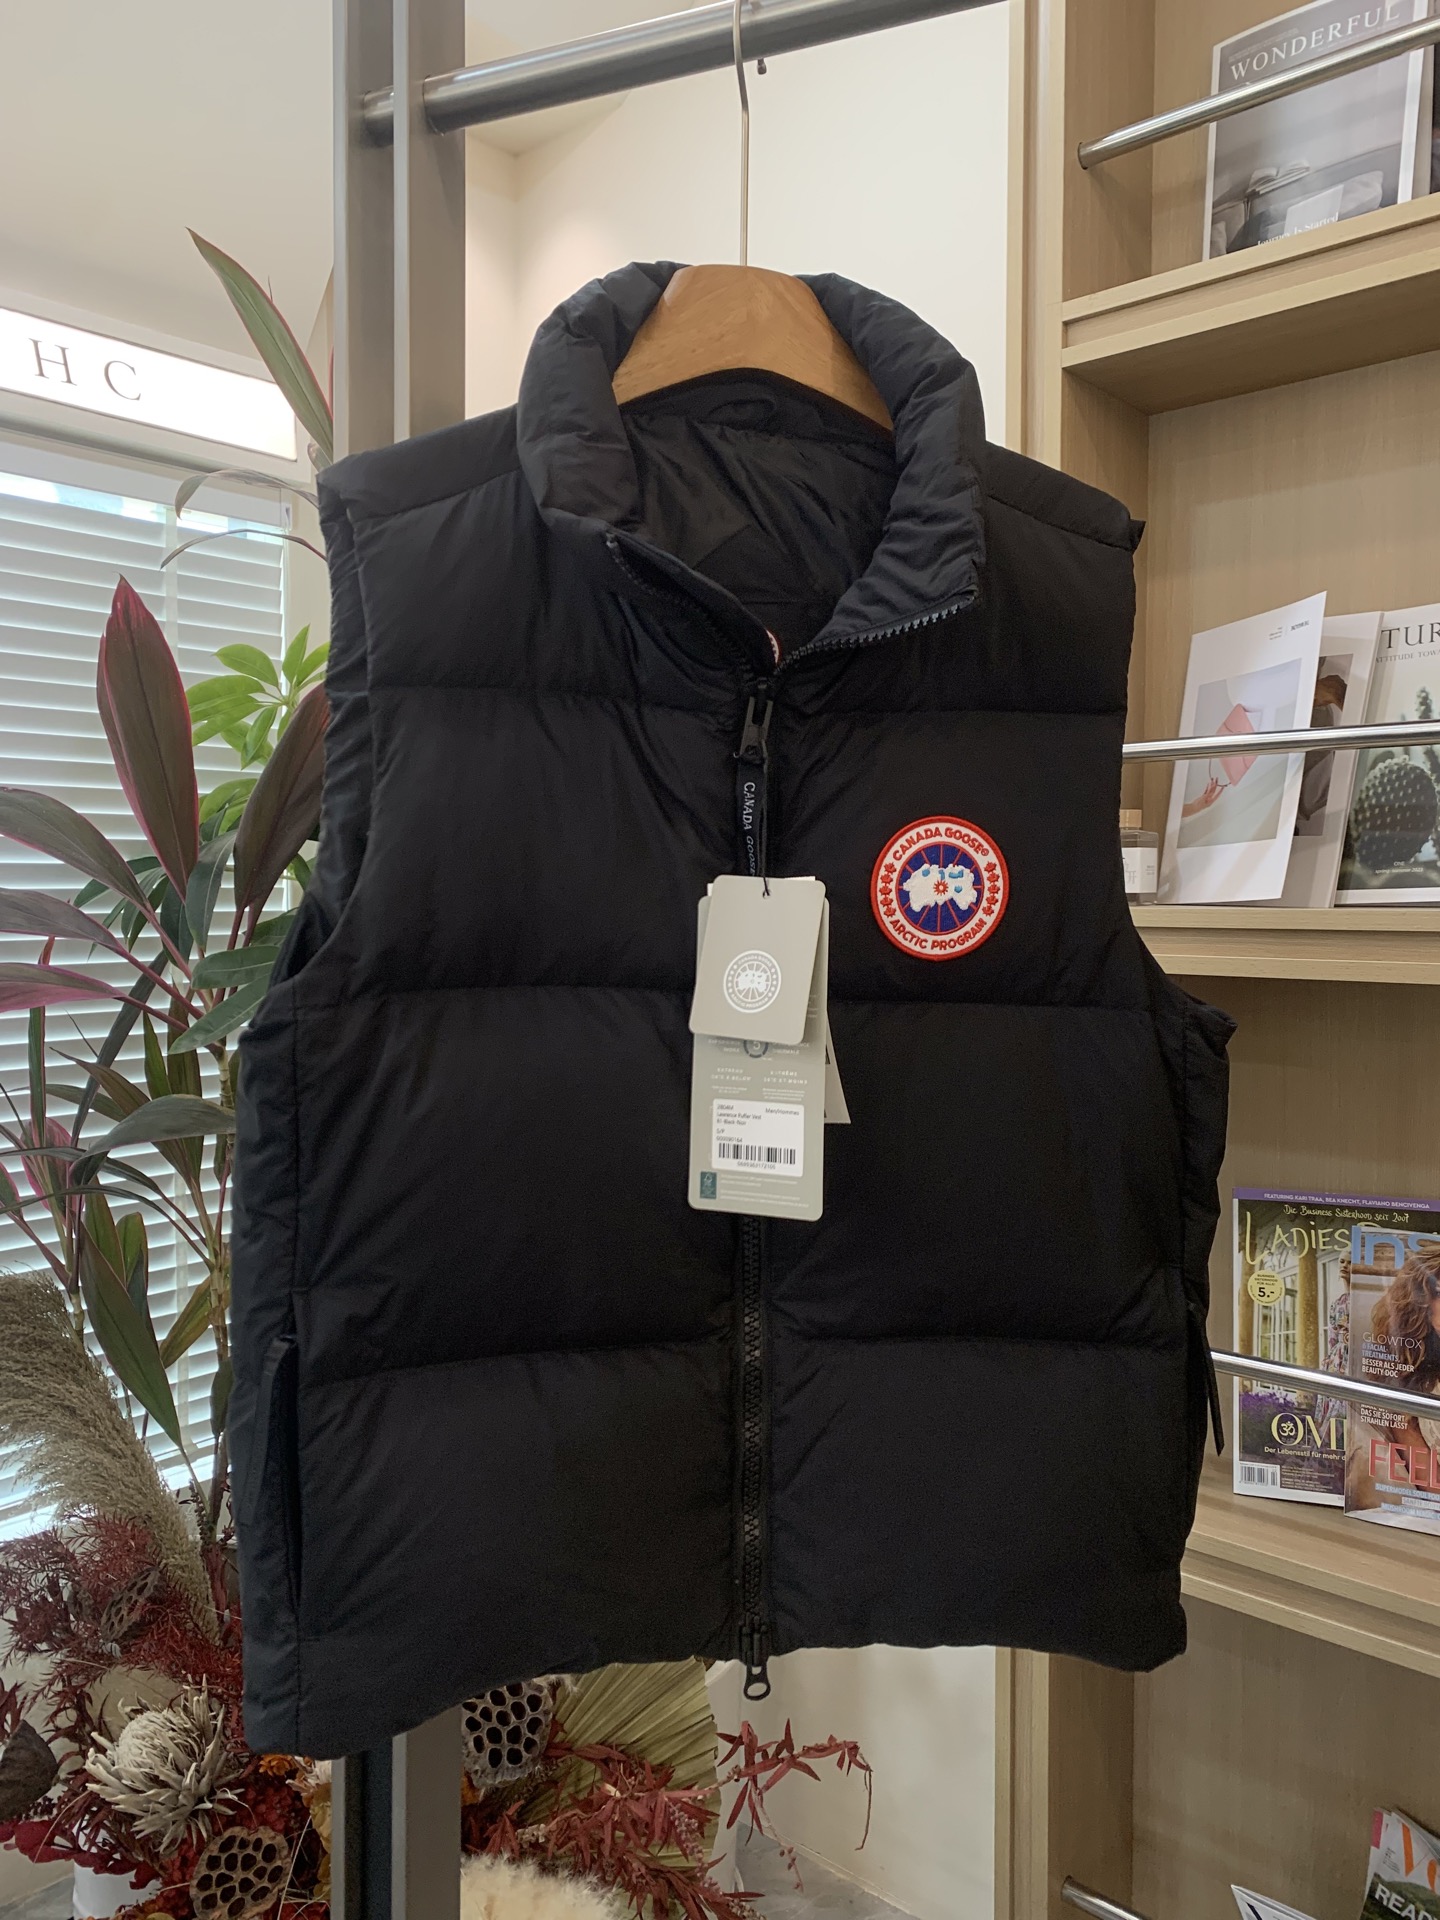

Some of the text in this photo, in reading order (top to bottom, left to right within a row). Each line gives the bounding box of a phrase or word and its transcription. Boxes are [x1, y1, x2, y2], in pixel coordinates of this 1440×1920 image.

[1230, 3, 1401, 81] WONDERFUL
[742, 781, 756, 830] CANADA
[892, 826, 943, 861] CANADA
[889, 917, 988, 951] ARCTIC PROGRAM
[1263, 1192, 1294, 1201] FEATURING
[1294, 1193, 1308, 1201] KARI
[1325, 1196, 1337, 1204] BEA
[1362, 1198, 1391, 1207] FLAVIANO
[1391, 1200, 1430, 1210] BENCIVENGA
[1300, 1204, 1333, 1217] Business
[1392, 1211, 1410, 1224] 2007
[1362, 1331, 1423, 1349] GLOWTOX
[1362, 1357, 1415, 1373] BESSER ALS JEDER
[1360, 1408, 1406, 1422] DAS SIE SOFORT
[1360, 1415, 1390, 1428] STRAHLEN
[1277, 1447, 1311, 1457] Lebensstil
[1311, 1450, 1322, 1458] für
